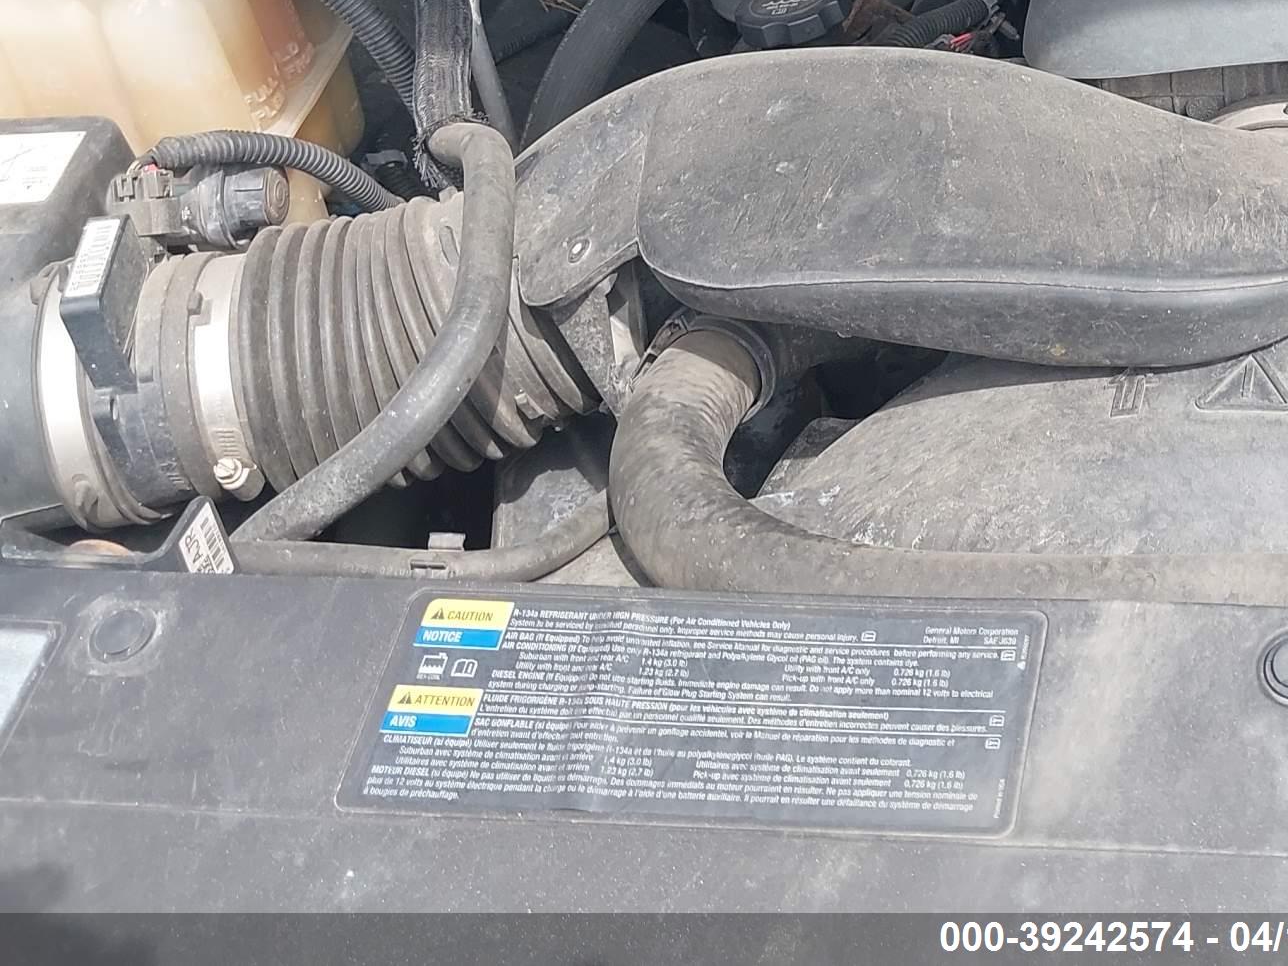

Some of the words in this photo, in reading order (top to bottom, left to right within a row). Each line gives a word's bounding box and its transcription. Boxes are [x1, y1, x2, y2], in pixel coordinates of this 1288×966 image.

[447, 610, 494, 622] CAUTION
[540, 610, 588, 620] REFRIGERANT
[613, 611, 630, 620] HIGH
[631, 612, 669, 624] PRESSURE
[772, 621, 790, 631] Only)
[510, 618, 535, 629] System
[805, 631, 835, 643] personal
[925, 627, 951, 636] General
[979, 627, 1019, 638] Corporation
[423, 631, 463, 643] NOTICE
[502, 641, 514, 650] AIR
[516, 642, 566, 652] CONDITIONING
[505, 631, 518, 640] AIR
[519, 632, 534, 641] BAG
[851, 647, 890, 658] procedures
[518, 652, 552, 662] Suburban
[841, 666, 854, 675] A/C
[492, 670, 516, 679] DIESEL
[518, 671, 545, 681] ENGINE
[834, 685, 853, 696] apply
[893, 687, 920, 697] nominal
[845, 676, 858, 685] A/C
[413, 694, 475, 707] ATTENTION
[483, 694, 508, 703] FLUIDE
[584, 696, 603, 706] SOUS
[631, 700, 667, 712] PRESSION
[389, 715, 417, 728] AVIS
[474, 718, 490, 727] SAC
[492, 718, 533, 728] GONFLABLE
[371, 765, 402, 775] MOTEUR
[404, 766, 429, 776] DIESEL
